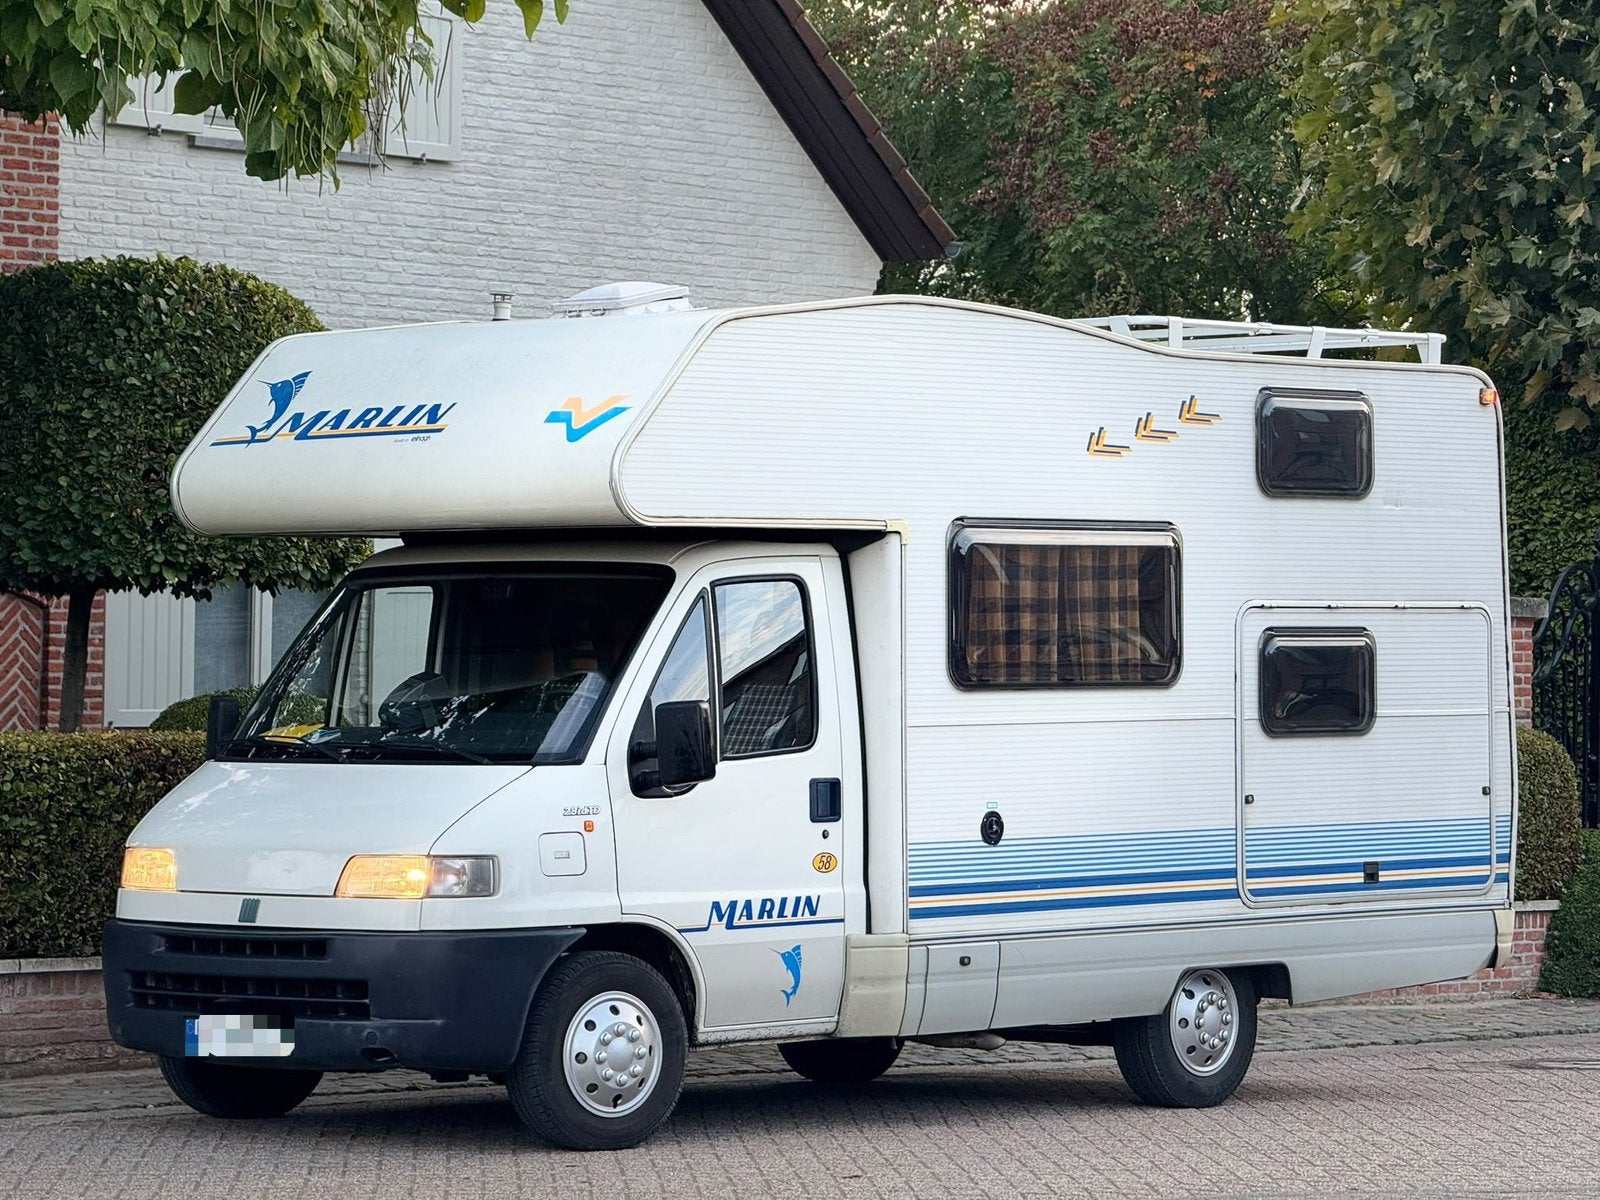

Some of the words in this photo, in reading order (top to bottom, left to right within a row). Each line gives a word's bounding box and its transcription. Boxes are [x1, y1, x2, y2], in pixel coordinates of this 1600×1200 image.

[269, 402, 457, 440] MARLIN
[817, 855, 832, 870] 58
[708, 895, 821, 930] MARLIN
